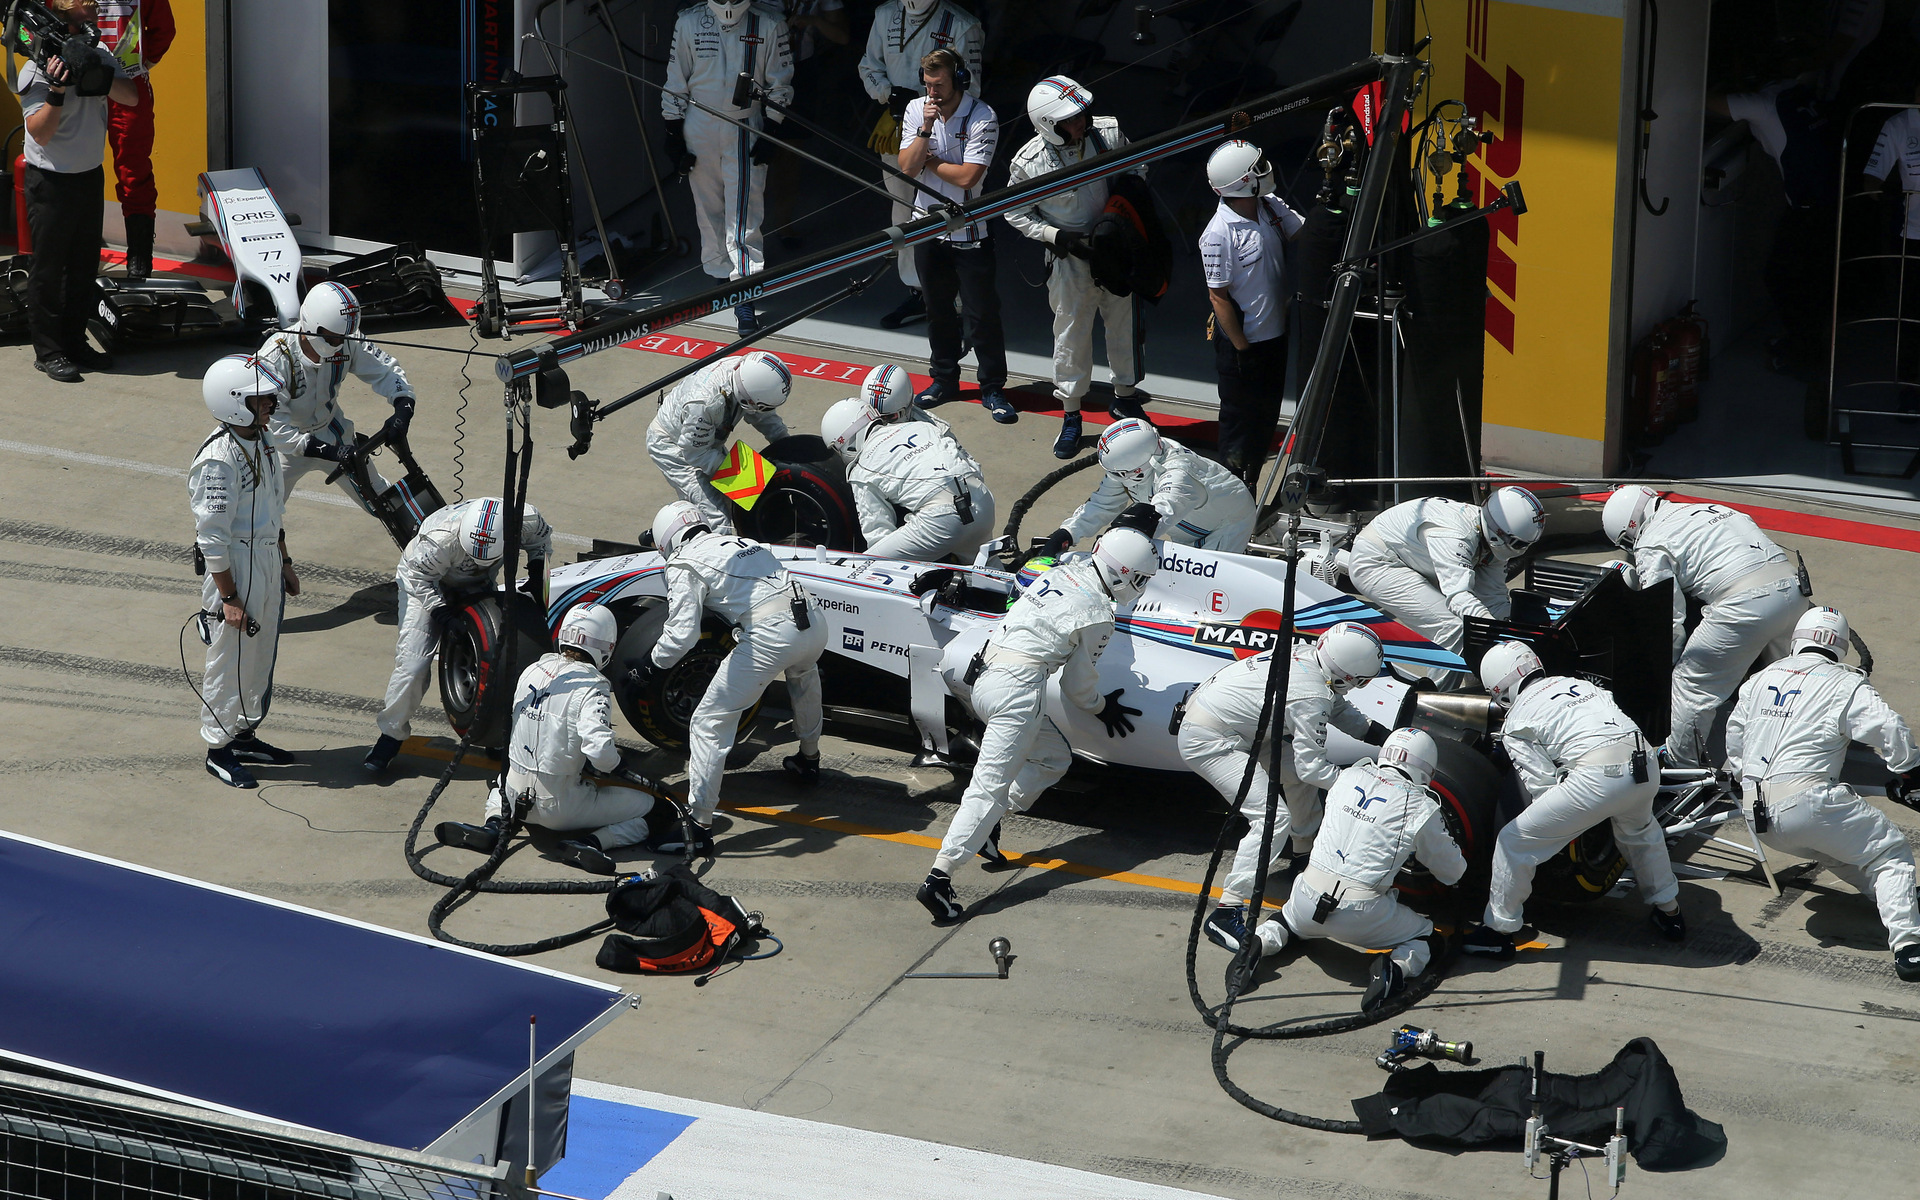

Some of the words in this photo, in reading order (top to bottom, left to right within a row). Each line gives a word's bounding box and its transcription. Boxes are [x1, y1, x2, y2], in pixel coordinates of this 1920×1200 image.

[485, 0, 498, 80] ARTINI
[931, 32, 954, 43] MARTINI
[1253, 107, 1283, 122] THOMSON
[1283, 97, 1310, 113] REUTERS
[237, 195, 267, 203] Experian
[231, 210, 276, 222] ORIS
[241, 232, 285, 243] PIRELLI
[258, 250, 282, 262] 77
[582, 322, 649, 355] WILLIAMS
[650, 301, 712, 332] MARTINI
[711, 285, 764, 312] RACING
[325, 355, 349, 363] MARTINI
[867, 384, 891, 395] MARTINI
[903, 441, 935, 461] randstad
[470, 533, 496, 543] MARTINI
[1157, 553, 1218, 578] ndstad
[1211, 592, 1223, 612] E
[844, 634, 863, 648] BR
[870, 640, 909, 657] PETRO
[1760, 707, 1794, 719] randstad
[1342, 804, 1377, 824] randstad
